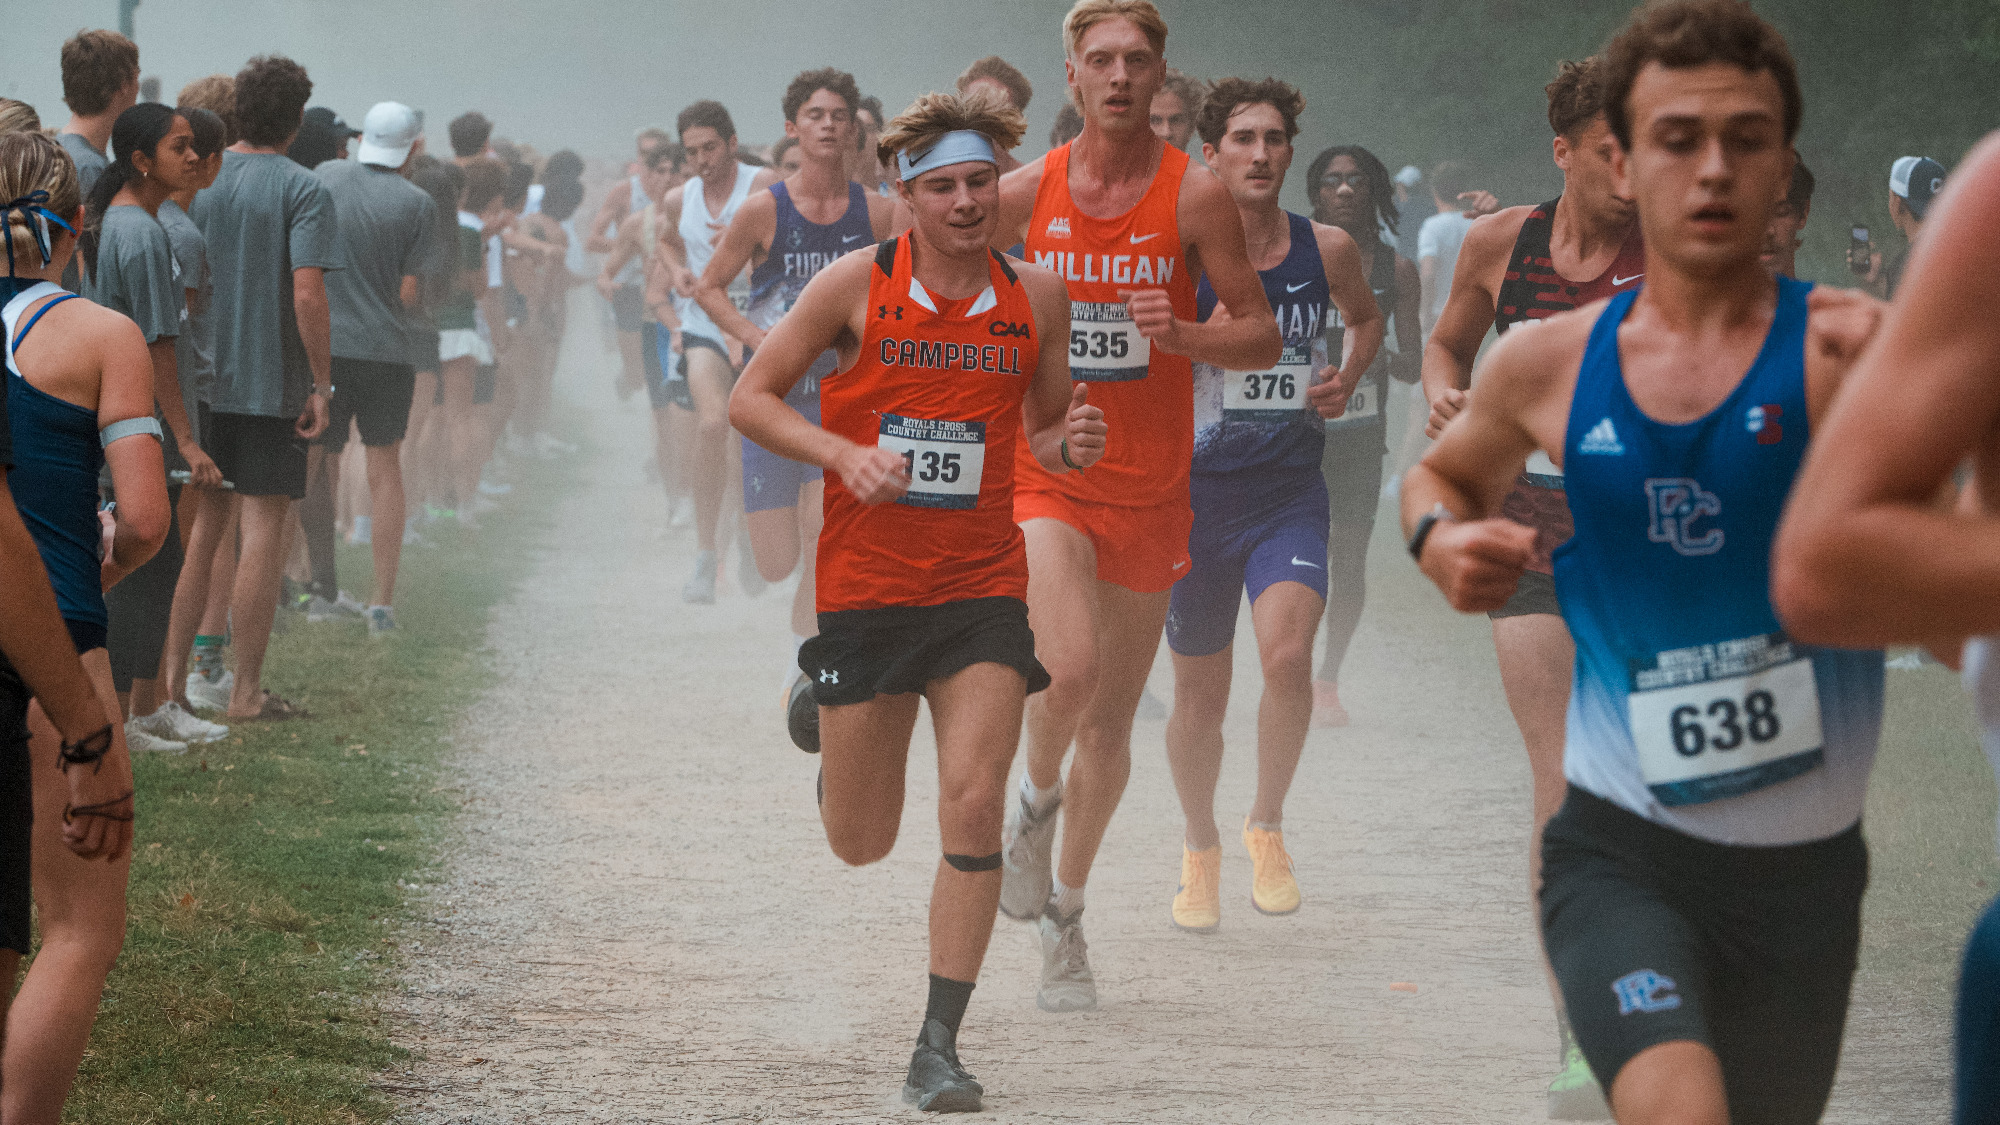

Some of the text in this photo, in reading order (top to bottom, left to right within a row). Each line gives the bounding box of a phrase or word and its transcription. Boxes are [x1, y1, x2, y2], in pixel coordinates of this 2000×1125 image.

[784, 250, 849, 278] FURM
[1034, 250, 1175, 285] MILLIGAN
[989, 321, 1030, 339] CAA
[1070, 330, 1129, 358] 535
[880, 337, 1022, 375] CAMPBELL
[1244, 373, 1295, 400] 376
[887, 424, 979, 442] COUNTRY CHALLENGE
[903, 417, 967, 432] ROYALS CROSS
[901, 449, 961, 484] 135
[1670, 690, 1781, 757] 638
